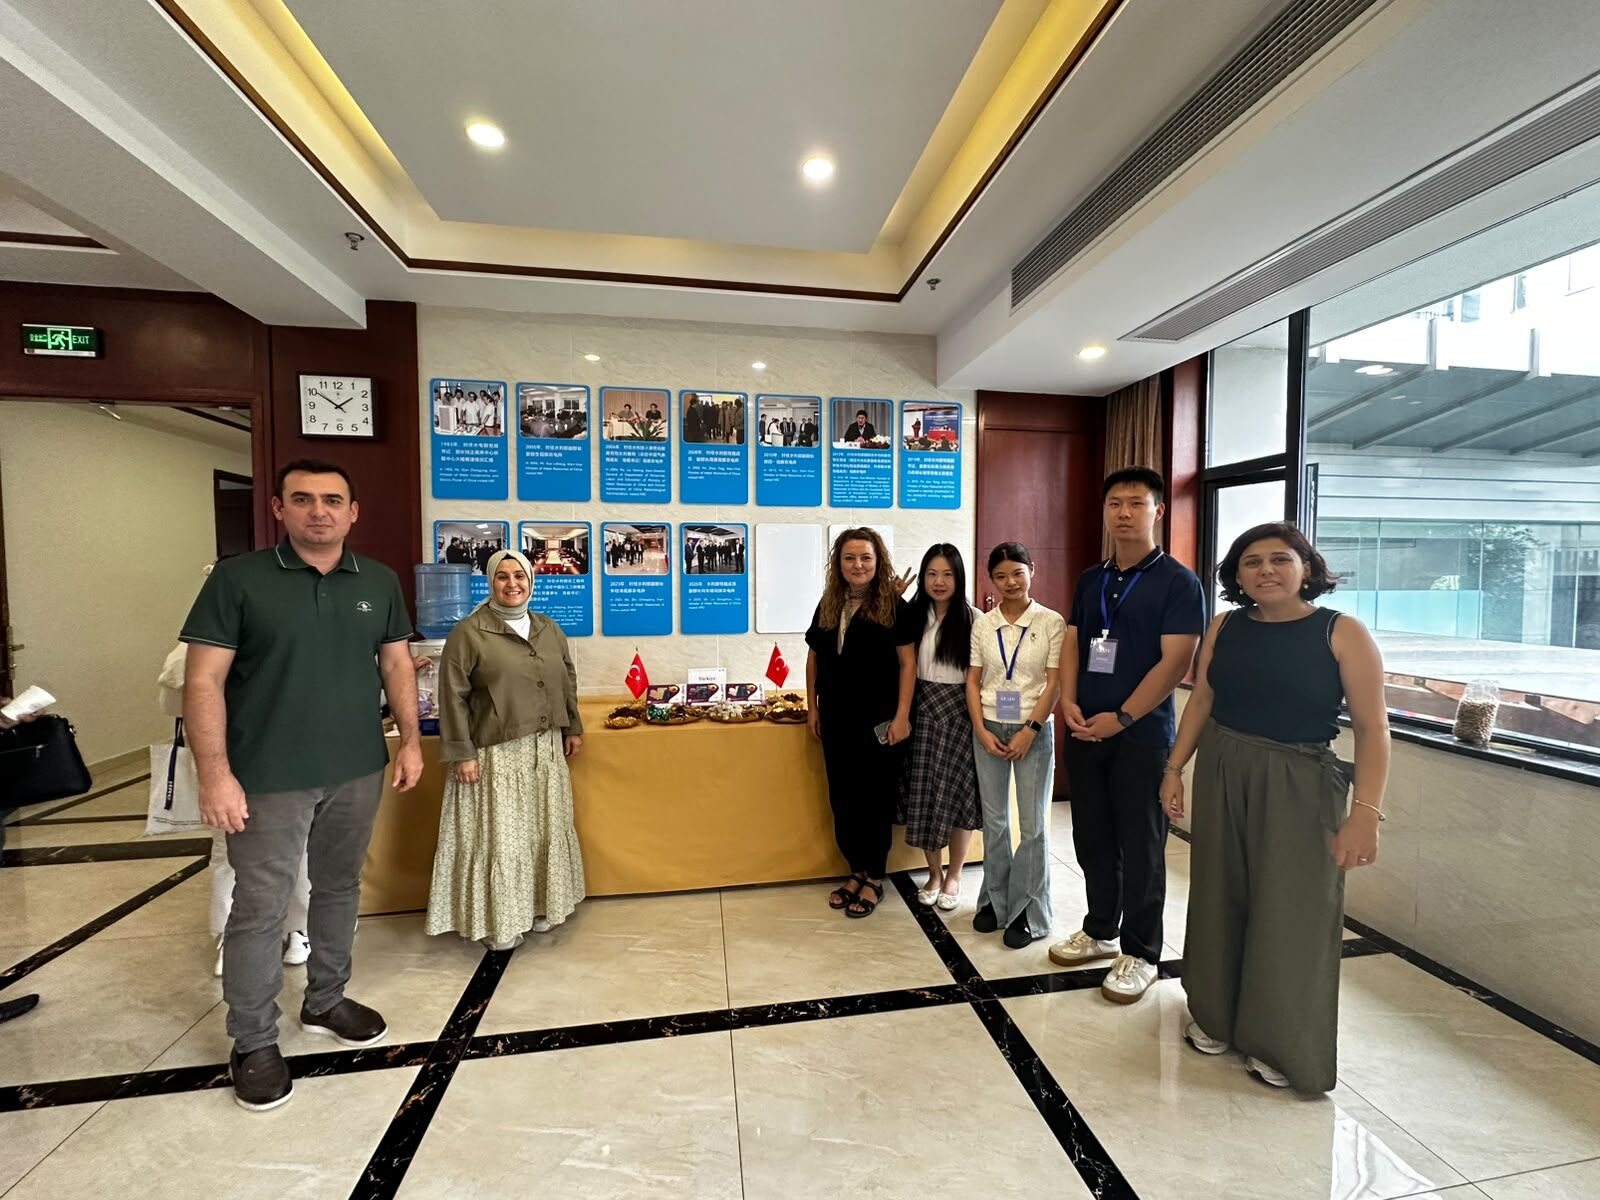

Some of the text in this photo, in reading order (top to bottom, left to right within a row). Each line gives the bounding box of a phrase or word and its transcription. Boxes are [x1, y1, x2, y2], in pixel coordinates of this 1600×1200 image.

[72, 335, 89, 344] EXIT
[320, 381, 328, 389] 11
[332, 382, 344, 390] 12
[308, 387, 318, 396] 10
[361, 390, 368, 398] 2
[308, 401, 316, 410] 9
[362, 404, 369, 412] 3
[309, 415, 316, 423] 8
[322, 422, 328, 431] 7
[336, 423, 344, 431] 6
[351, 424, 358, 432] 5
